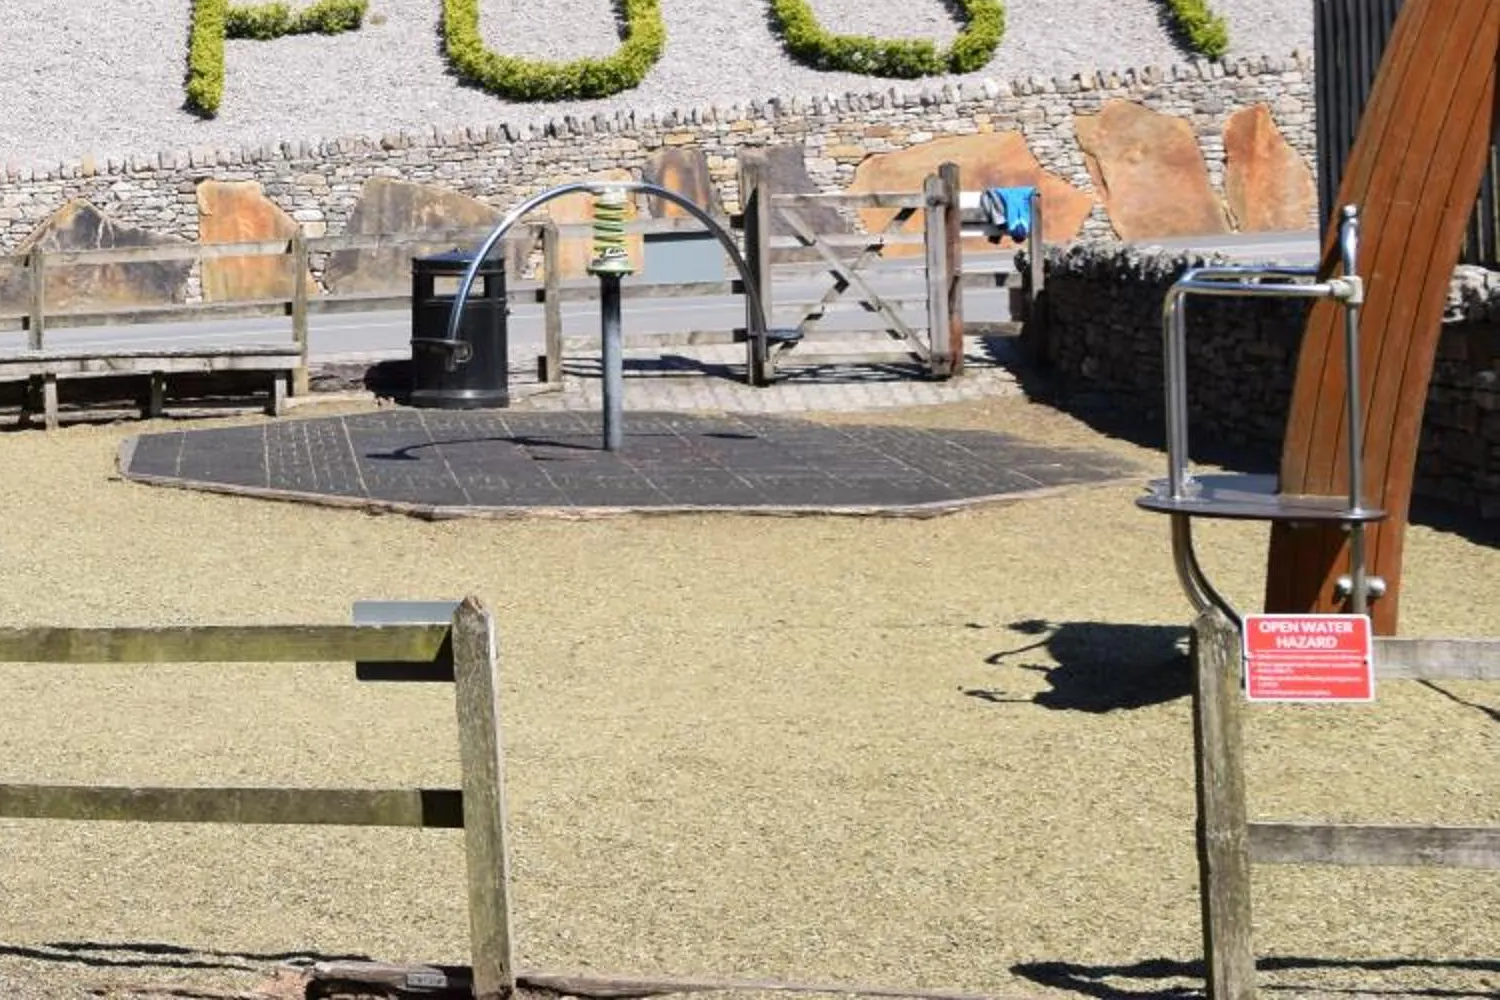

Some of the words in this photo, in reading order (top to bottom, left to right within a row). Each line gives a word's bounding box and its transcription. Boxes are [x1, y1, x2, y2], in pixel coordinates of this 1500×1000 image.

[1259, 621, 1299, 633] OPEN
[1301, 621, 1353, 633] WATER
[1276, 636, 1338, 649] HAZARD
